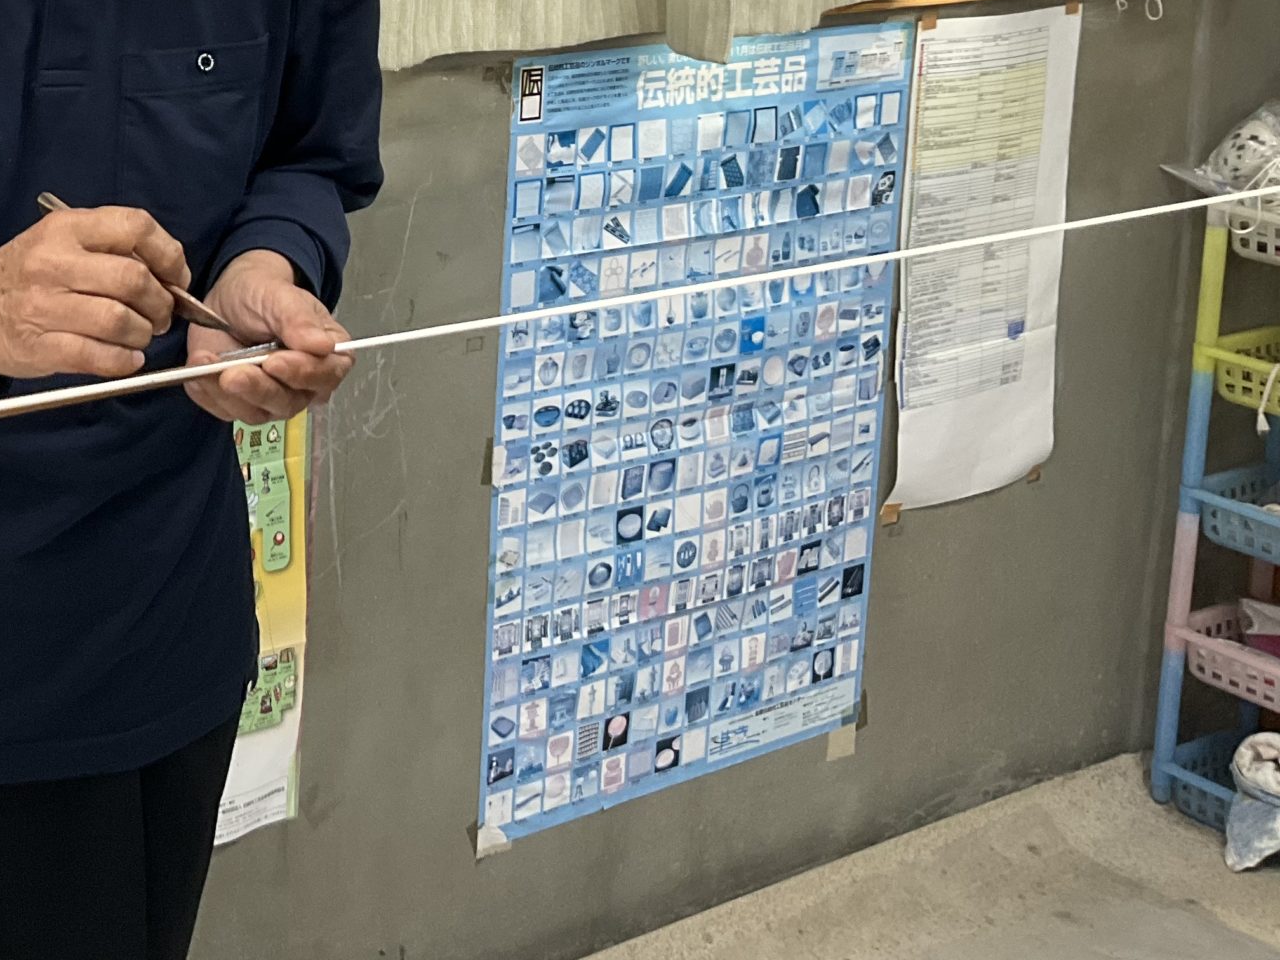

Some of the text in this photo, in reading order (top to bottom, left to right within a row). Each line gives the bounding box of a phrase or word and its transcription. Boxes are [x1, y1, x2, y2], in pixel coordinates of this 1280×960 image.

[636, 54, 808, 110] 伝統的工芸品
